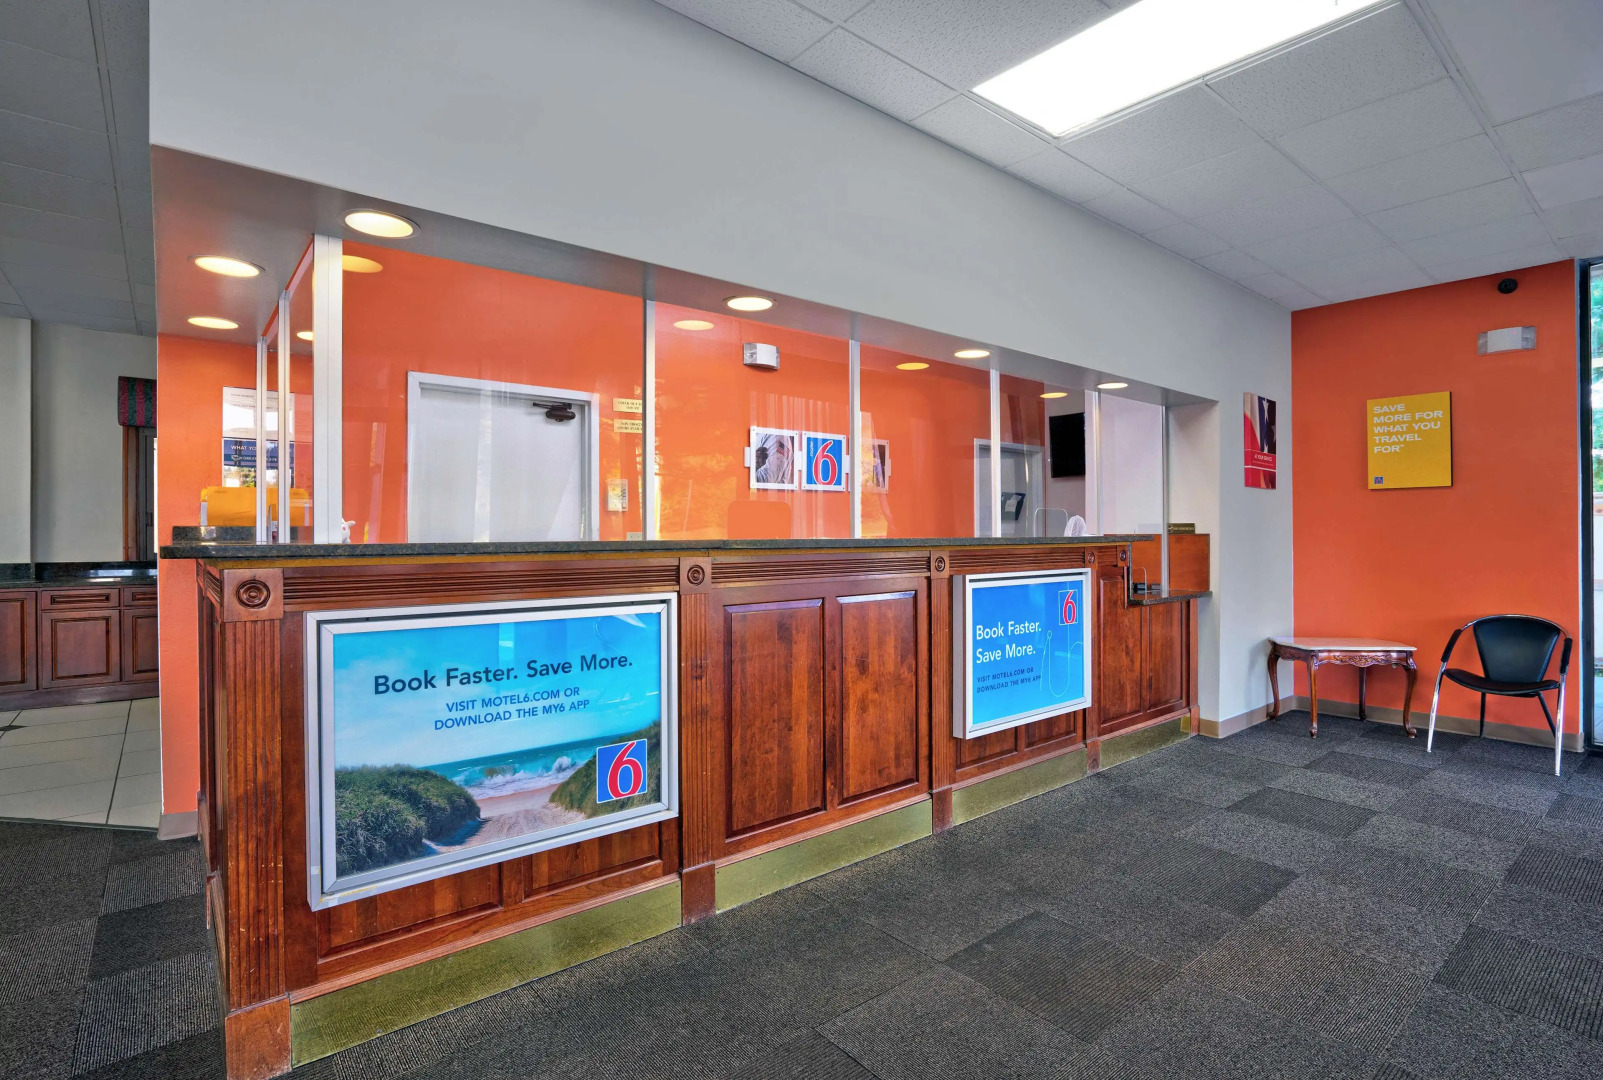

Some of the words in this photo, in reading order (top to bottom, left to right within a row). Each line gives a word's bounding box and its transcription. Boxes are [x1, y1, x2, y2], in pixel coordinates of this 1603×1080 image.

[1374, 404, 1406, 414] SAVE
[1374, 414, 1412, 423] MORE
[1416, 410, 1443, 420] FOR
[1374, 424, 1408, 434] WHAT
[1412, 421, 1440, 430] YOU
[1374, 434, 1422, 444] TRAVEL
[813, 440, 838, 486] 6
[1063, 590, 1076, 624] 6
[976, 622, 1004, 640] Book
[1008, 621, 1041, 636] Faster.
[976, 648, 1002, 664] Save
[1006, 643, 1036, 658] More.
[374, 670, 437, 695] Book
[446, 666, 518, 687] Faster.
[526, 659, 573, 678] Save
[580, 654, 633, 672] More.
[977, 675, 990, 683] VISIT
[992, 668, 1024, 680] MOTEL6.COM
[977, 682, 1008, 693] DOWNLOAD
[446, 699, 477, 713] VISIT
[482, 689, 560, 709] MOTEL6.COM
[564, 687, 580, 697] OR
[434, 711, 511, 730] DOWNLOAD
[516, 707, 539, 718] THE
[542, 703, 565, 715] MY6
[569, 700, 590, 711] APP
[607, 741, 643, 800] 6
